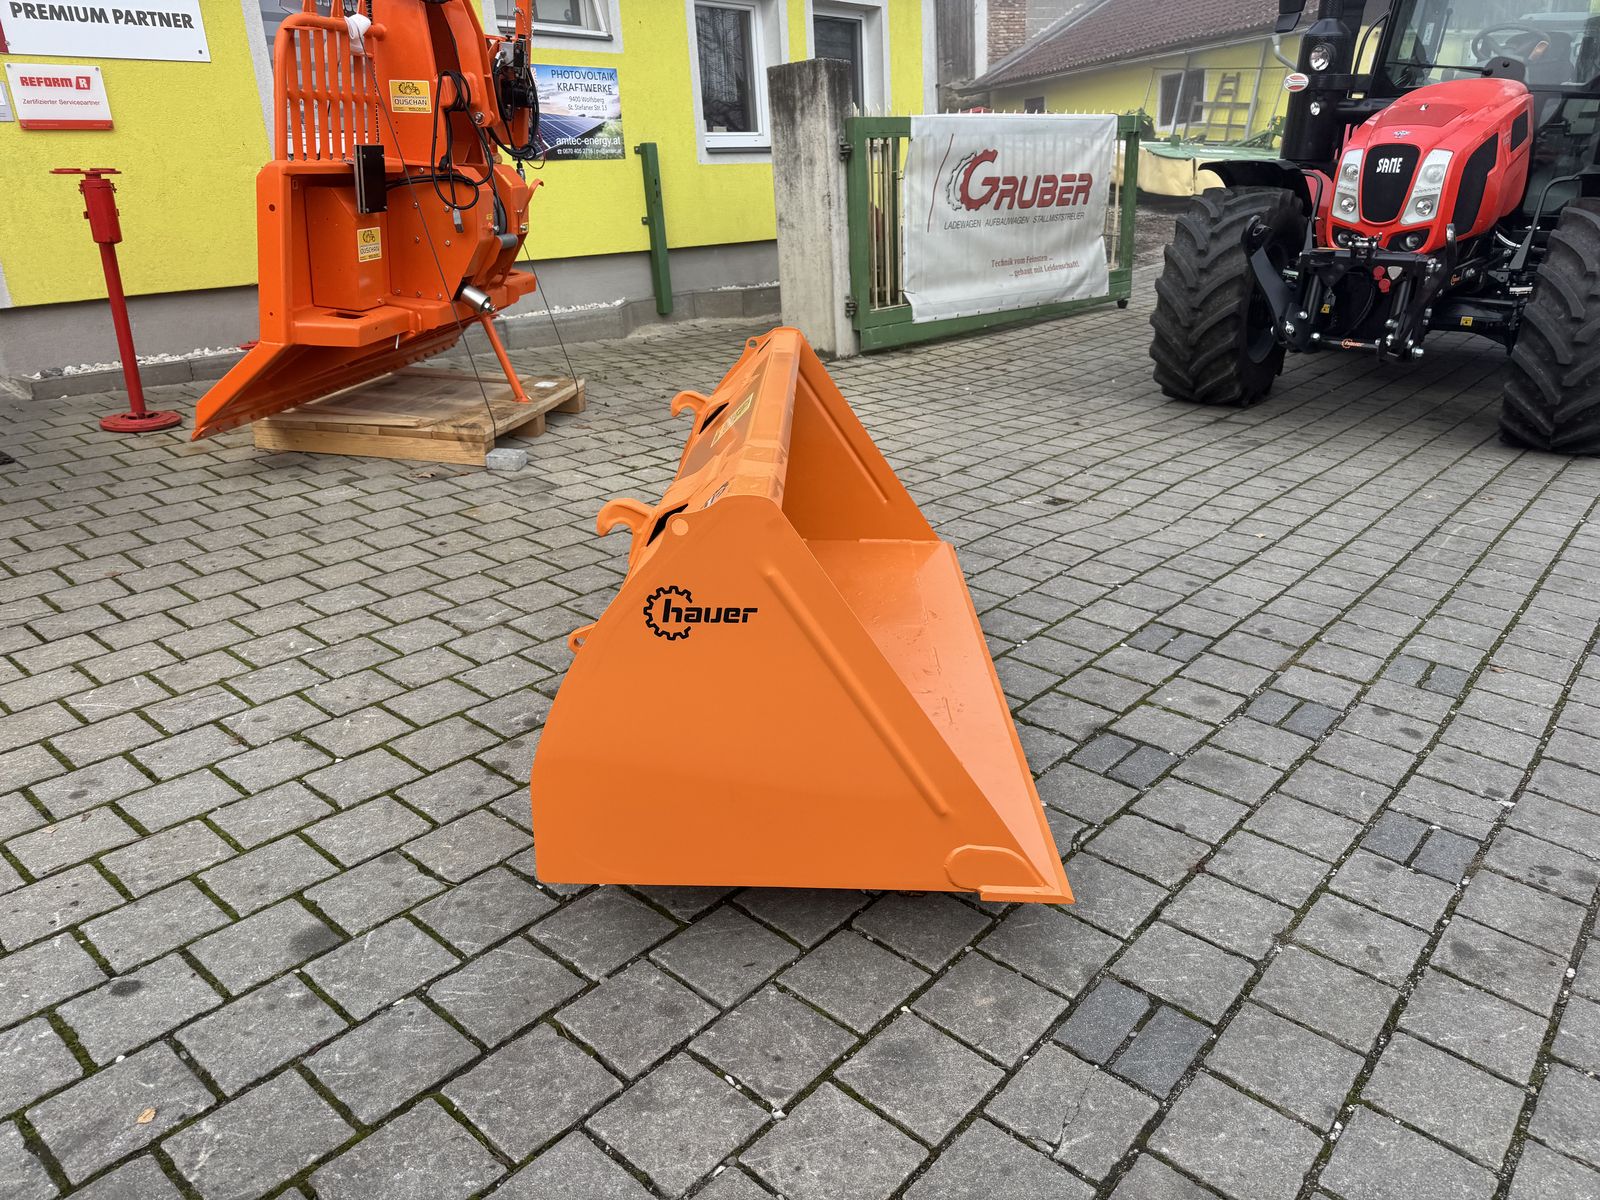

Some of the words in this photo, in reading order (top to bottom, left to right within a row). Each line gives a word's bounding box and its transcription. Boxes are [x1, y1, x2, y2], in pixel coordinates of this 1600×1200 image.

[9, 1, 109, 24] PREMIUM
[113, 8, 194, 29] PARTNER
[551, 69, 615, 81] PHOTOVOLTAIK
[19, 76, 73, 88] REFORM
[557, 82, 612, 93] KRAFTWERKE
[581, 96, 604, 104] Wolfsberg
[555, 136, 621, 148] amtec-energy.at
[1376, 157, 1404, 173] SAME
[958, 149, 1094, 212] GRUBER
[943, 219, 982, 231] LADEWAGEN
[984, 215, 1030, 226] AUFBAUWAGEN
[1032, 211, 1086, 224] STALLMISTSTREUER
[991, 257, 1013, 268] Technik
[1014, 257, 1025, 265] vom
[1026, 255, 1047, 264] Feinsten
[1014, 267, 1033, 278] gebaut
[1033, 266, 1044, 274] mit
[661, 598, 758, 624] hauer
